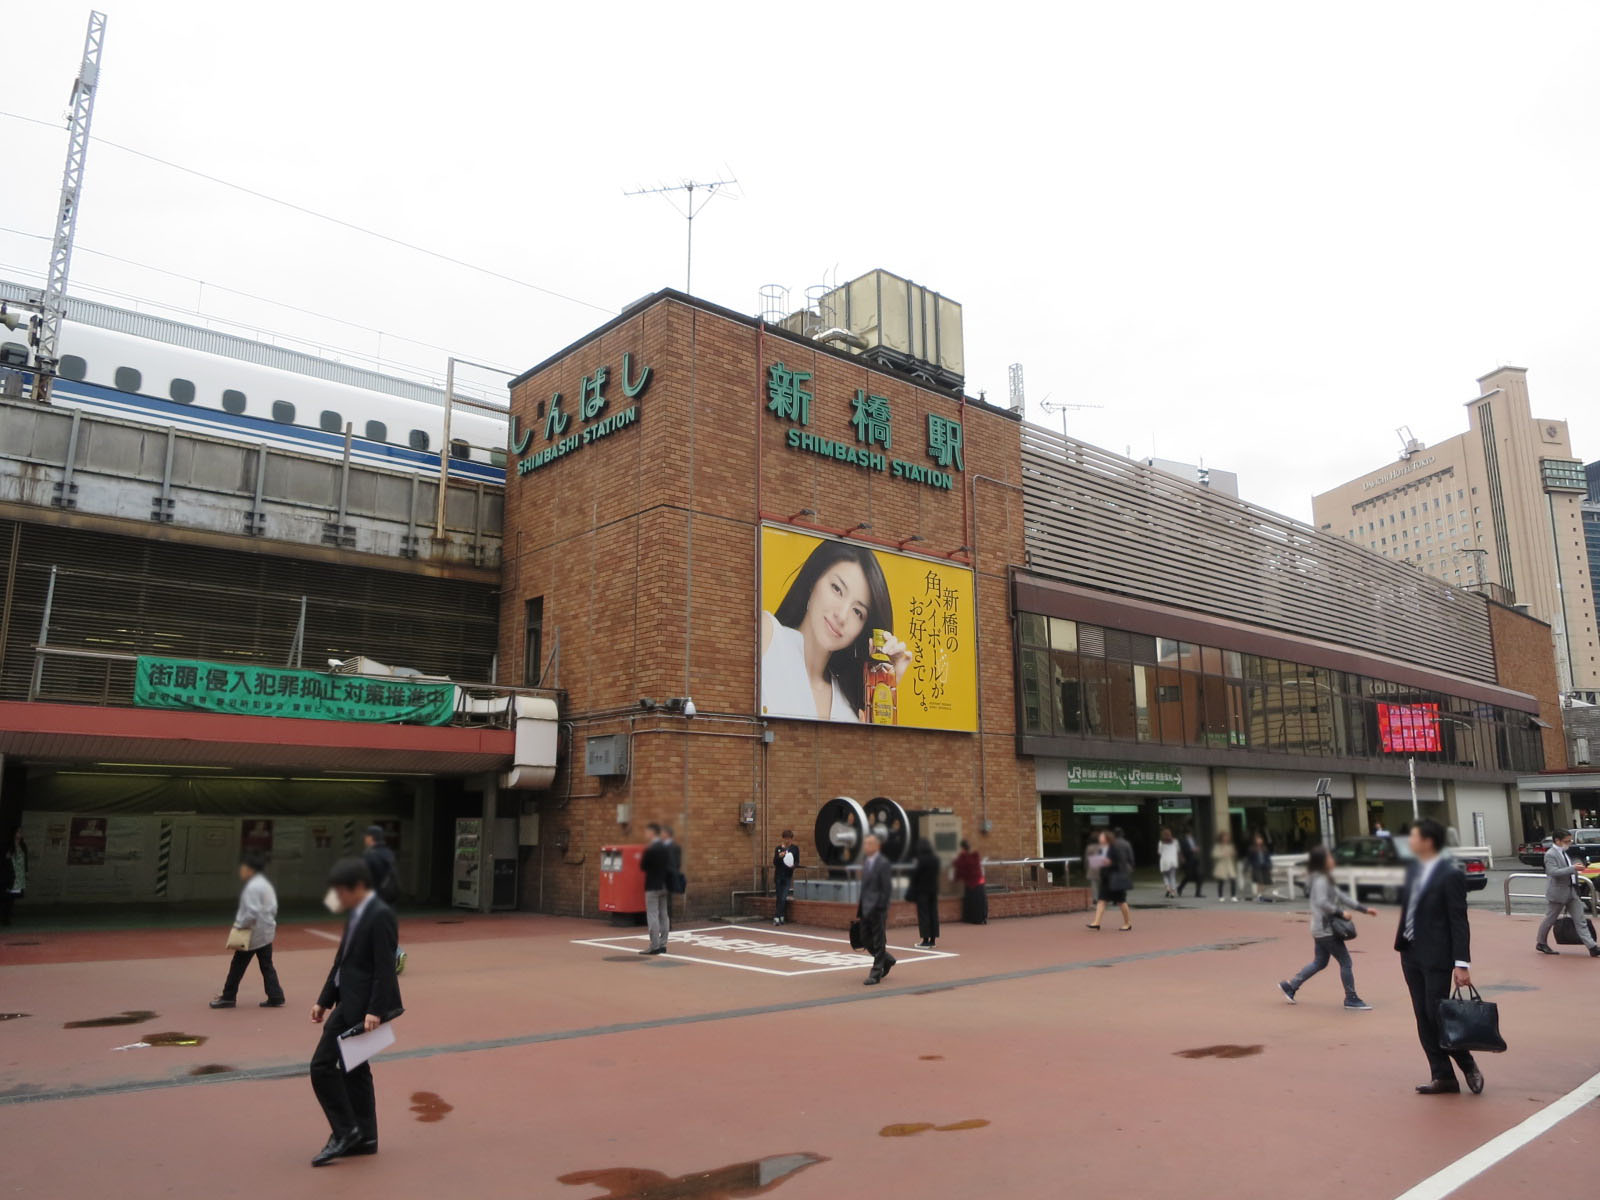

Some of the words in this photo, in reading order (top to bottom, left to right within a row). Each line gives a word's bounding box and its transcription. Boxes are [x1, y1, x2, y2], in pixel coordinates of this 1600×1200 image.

[510, 351, 650, 454] しんばし
[517, 433, 580, 475] SHIMBASHI
[582, 405, 637, 445] STATION
[767, 361, 965, 472] 新橋駅
[787, 427, 886, 472] SHIMBASHI
[891, 459, 953, 490] STATION
[908, 595, 929, 712] お好きでしょ。
[924, 569, 945, 700] 角ハイボールが
[941, 587, 960, 653] 新橋の
